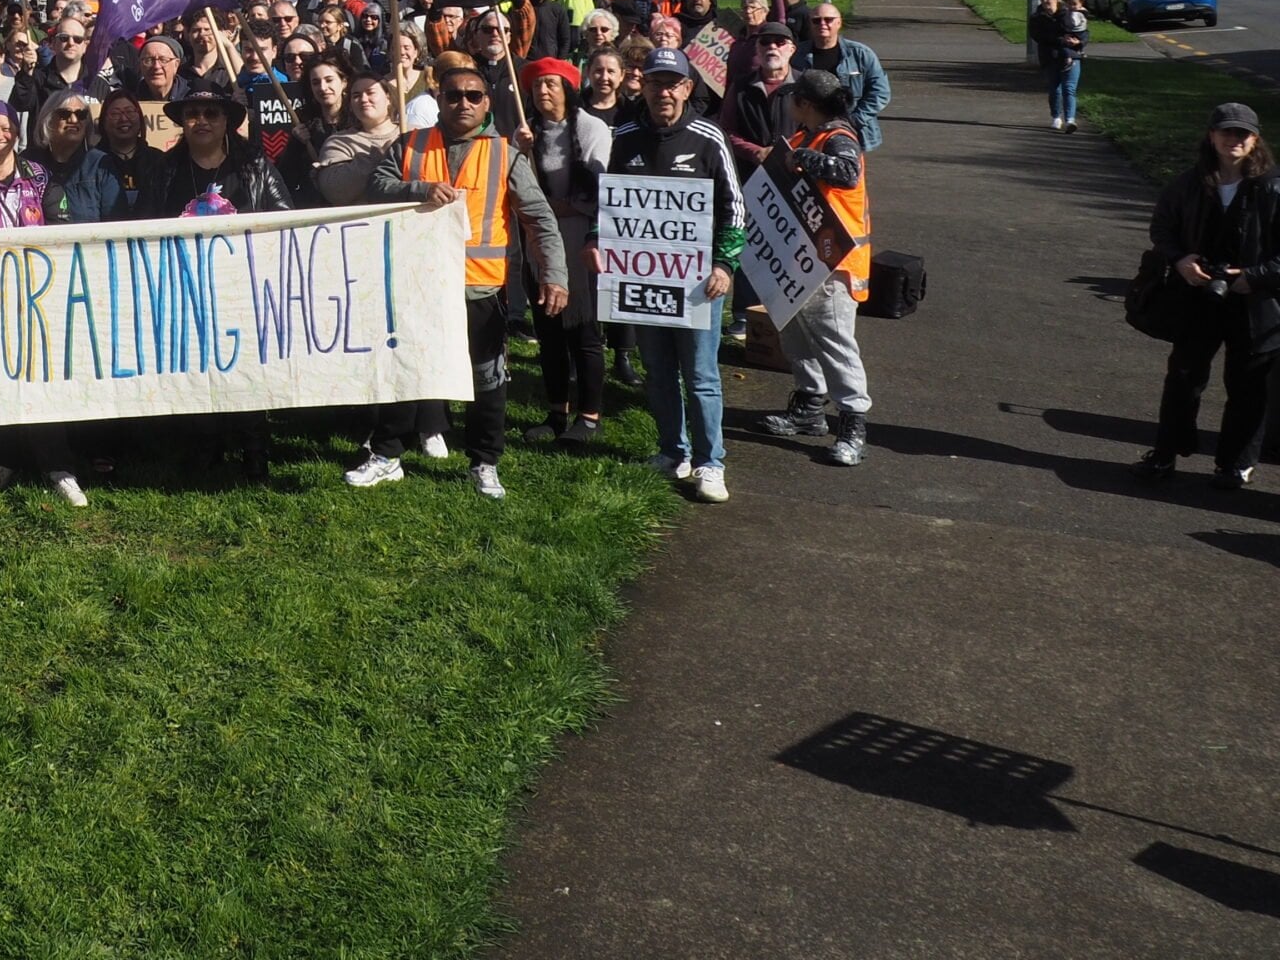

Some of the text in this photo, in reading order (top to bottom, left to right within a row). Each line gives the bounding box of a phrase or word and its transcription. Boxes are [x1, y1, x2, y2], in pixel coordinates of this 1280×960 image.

[260, 112, 292, 125] MAI!
[606, 187, 706, 212] LIVING
[612, 217, 697, 242] WAGE
[757, 182, 815, 274] Toot to
[603, 248, 704, 281] NOW!
[746, 212, 806, 304] upport!
[63, 242, 104, 380] A
[106, 232, 240, 378] LIVING
